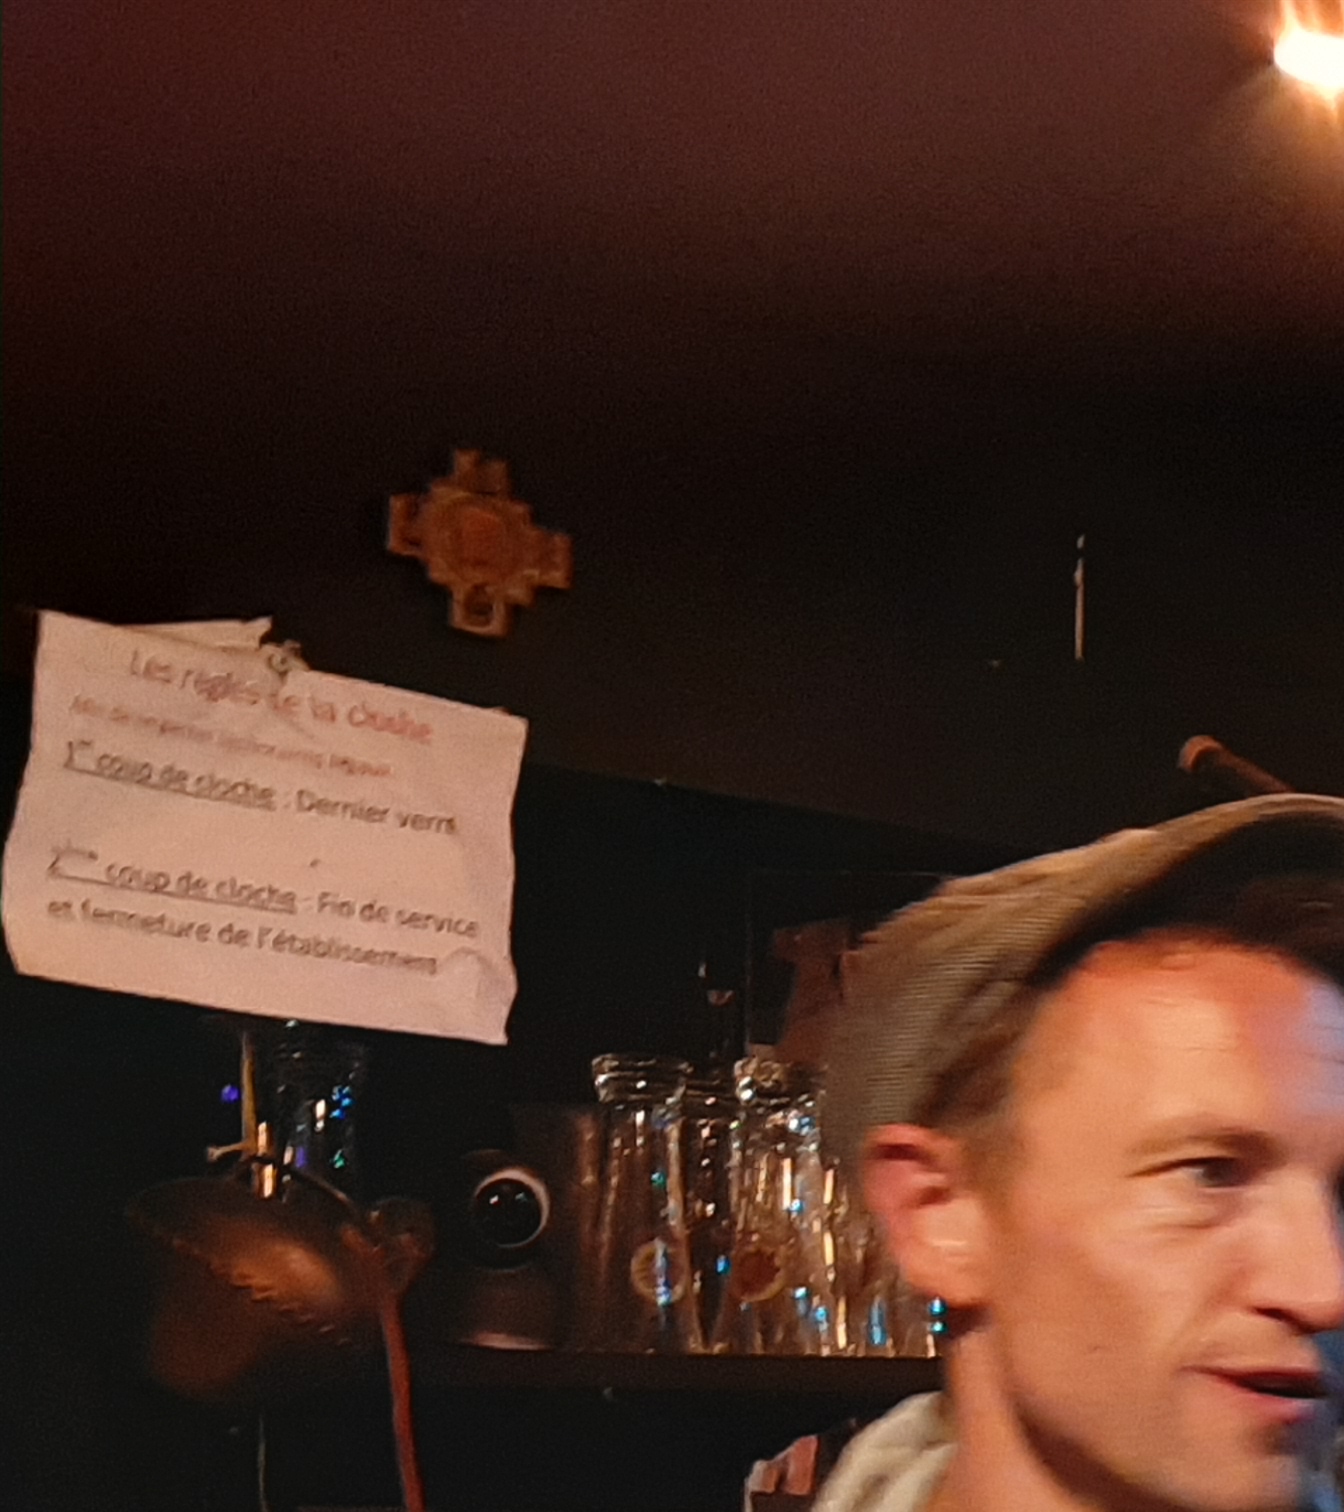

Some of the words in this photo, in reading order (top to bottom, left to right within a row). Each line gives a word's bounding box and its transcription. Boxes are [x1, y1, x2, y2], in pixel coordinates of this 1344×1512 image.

[296, 788, 390, 825] Dernier
[81, 898, 210, 942] fermeture
[217, 923, 250, 949] de
[105, 861, 171, 893] coup
[175, 869, 207, 895] de
[317, 891, 356, 917] Fin
[360, 898, 389, 922] de
[395, 908, 480, 938] service
